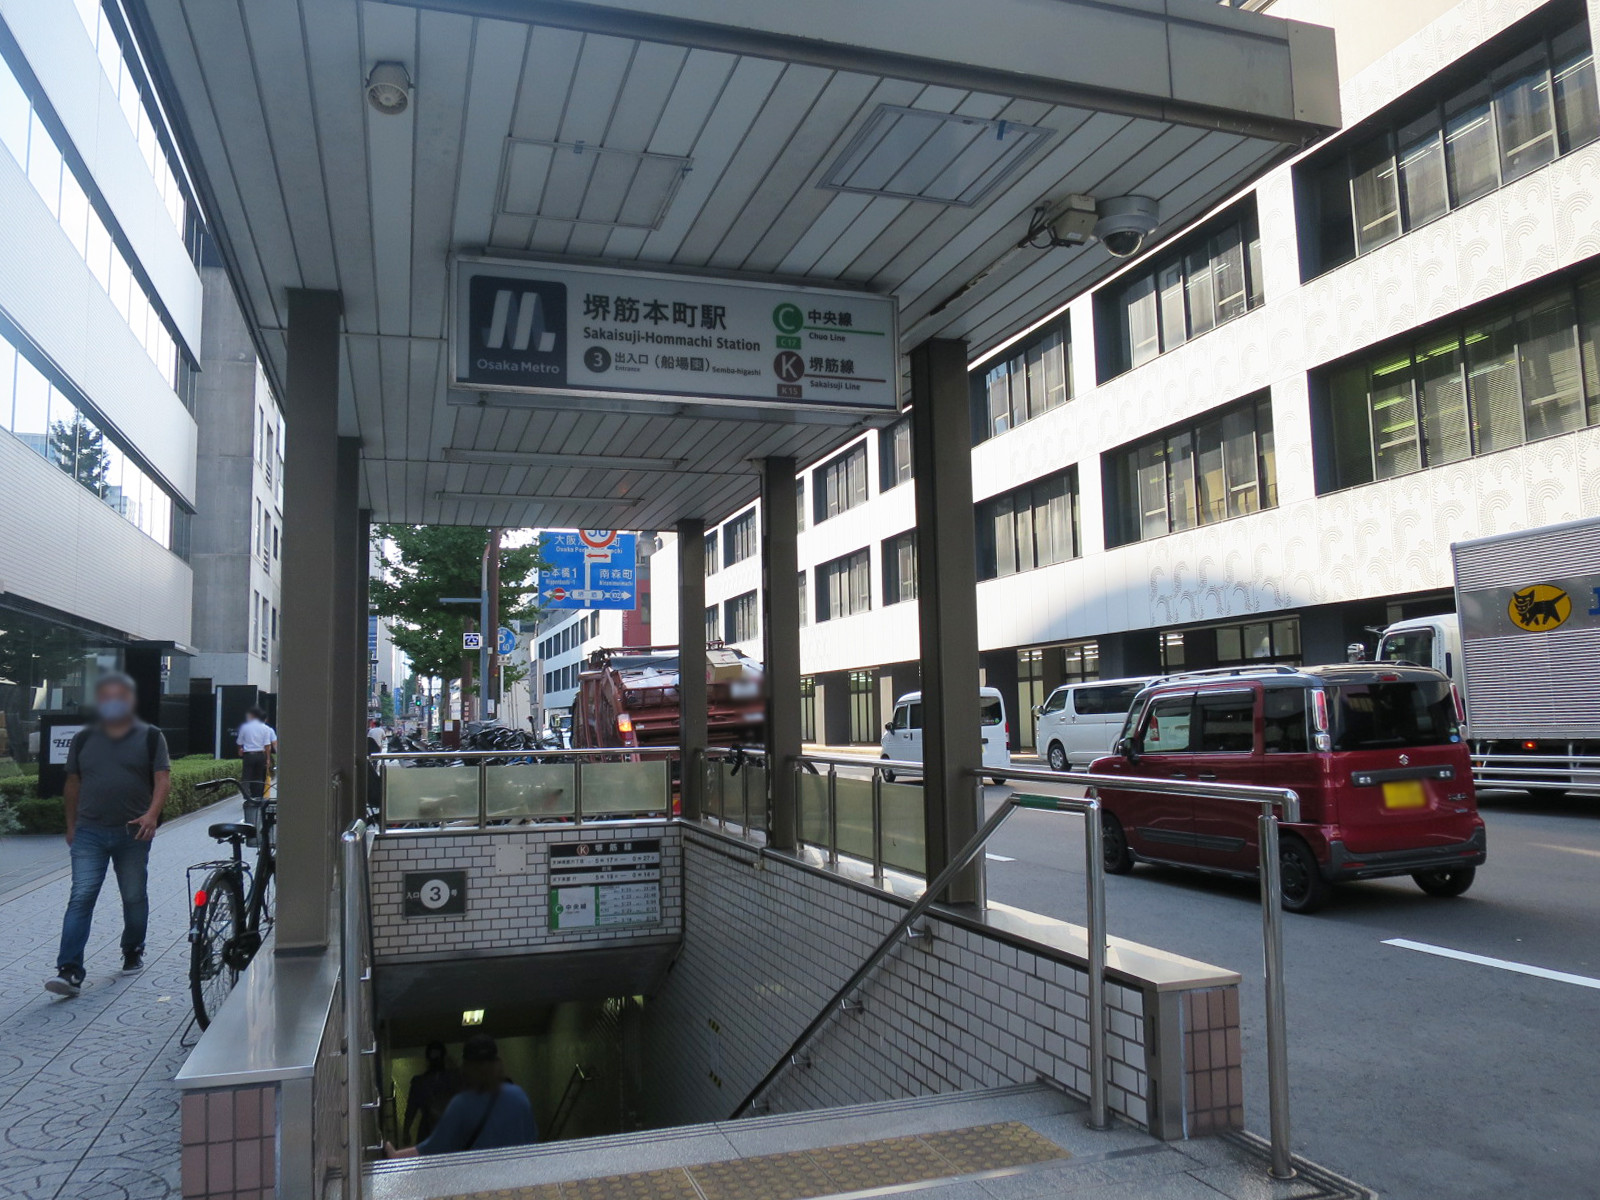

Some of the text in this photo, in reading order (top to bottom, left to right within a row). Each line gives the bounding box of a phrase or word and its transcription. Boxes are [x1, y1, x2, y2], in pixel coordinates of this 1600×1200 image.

[584, 293, 727, 330] 堺筋本町駅
[779, 307, 795, 329] C
[808, 309, 852, 327] 中央線
[583, 326, 761, 352] Sakaisuji-Hommachi Station
[781, 338, 797, 347] C17
[809, 331, 845, 342] Chuo Line
[477, 359, 561, 374] Osaka Metro
[614, 353, 649, 366] 出入口
[781, 355, 798, 378] K
[810, 357, 854, 374] 堺筋線
[712, 366, 762, 377] Semba-higashi
[781, 386, 798, 395] K15
[810, 379, 861, 391] Sakaisuji Line
[600, 569, 633, 579] 南森町
[497, 634, 506, 651] P
[429, 886, 442, 902] 3
